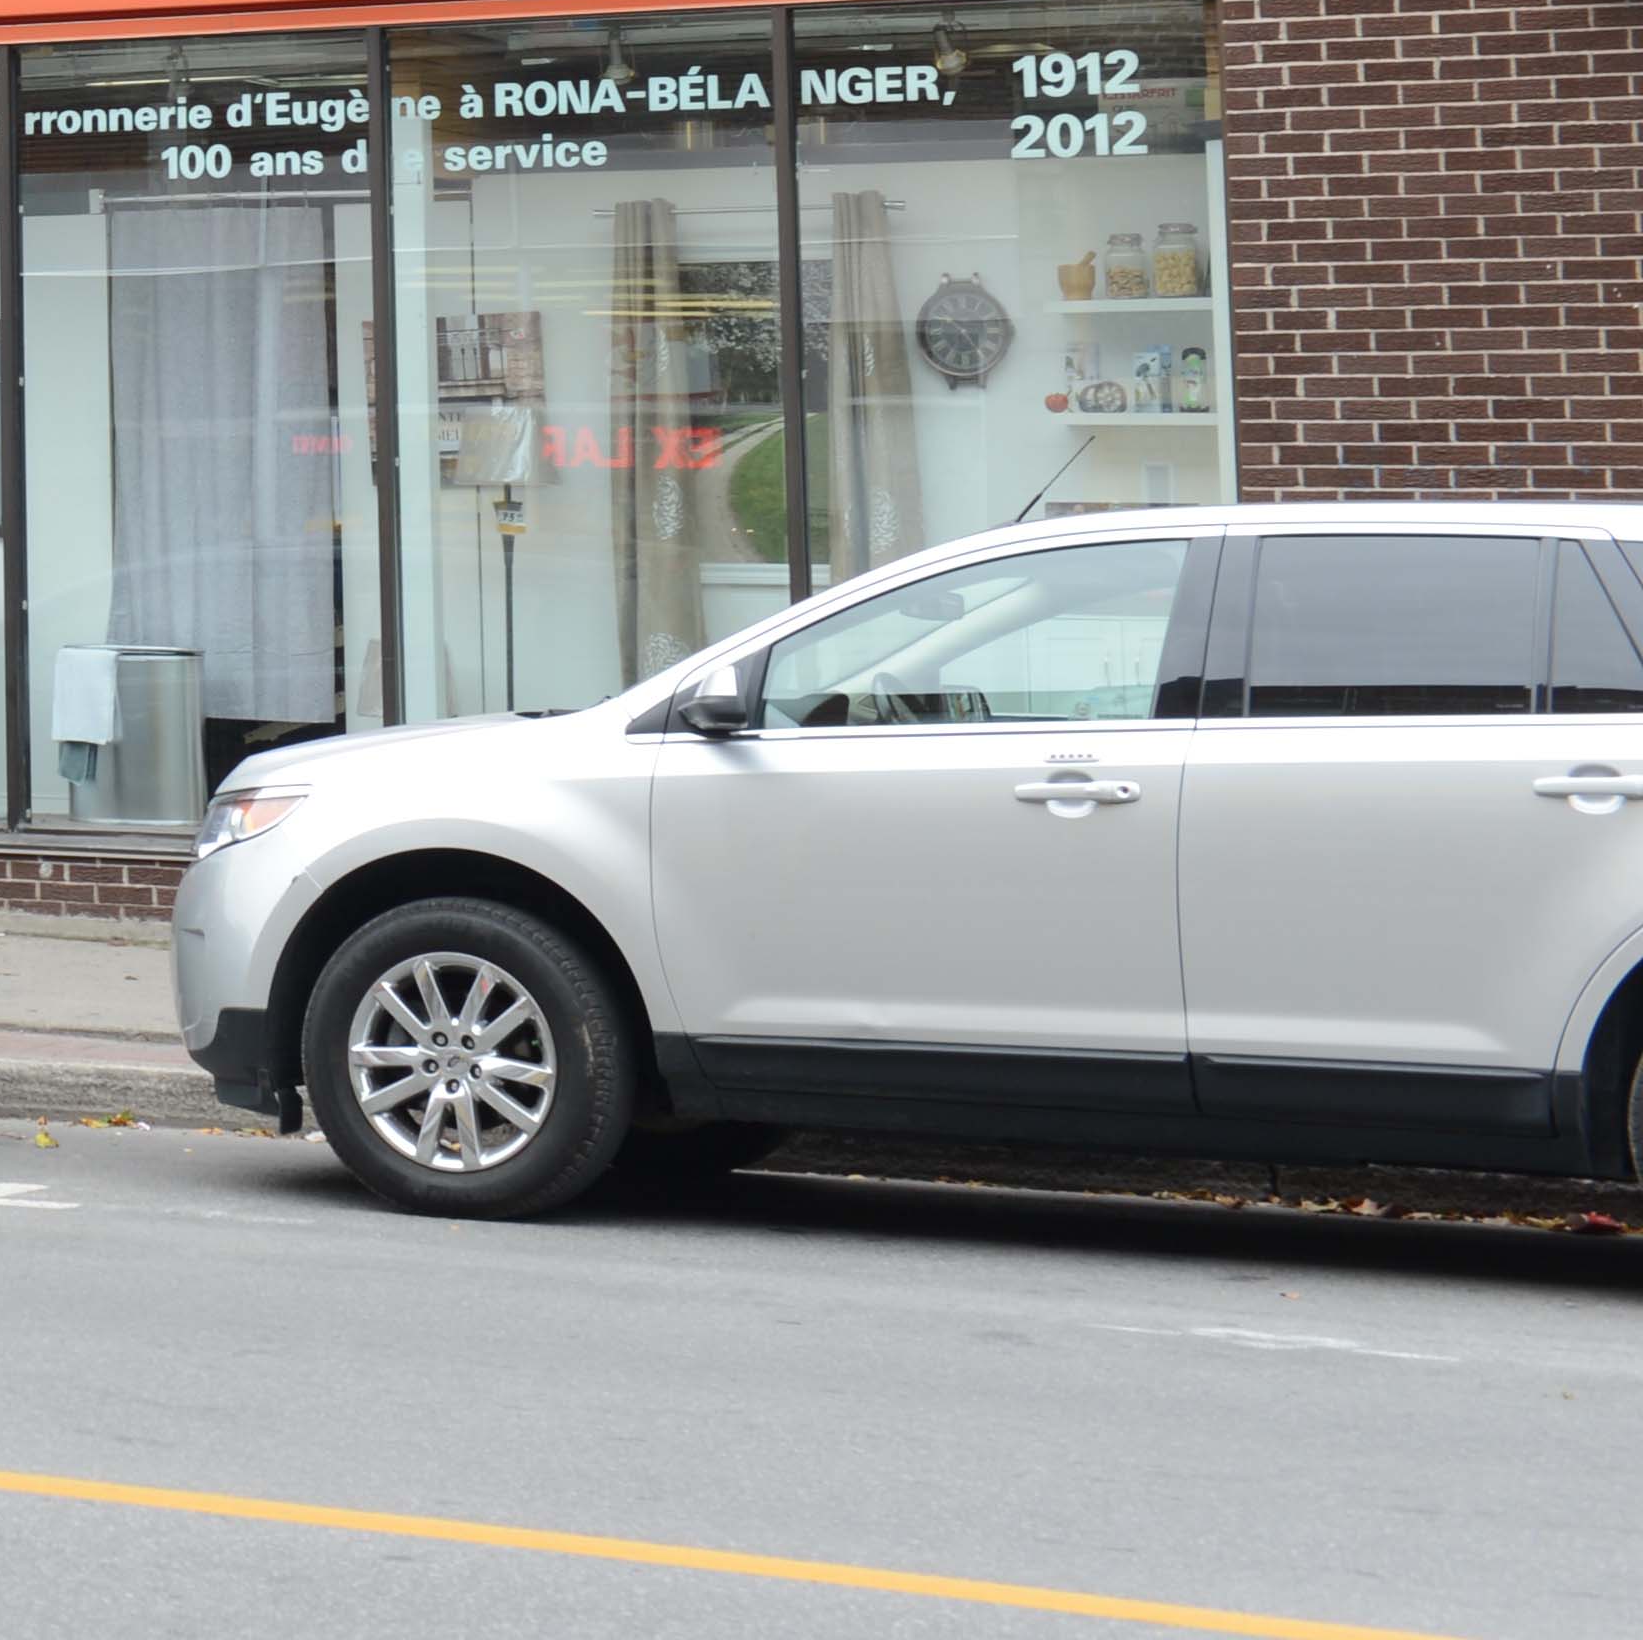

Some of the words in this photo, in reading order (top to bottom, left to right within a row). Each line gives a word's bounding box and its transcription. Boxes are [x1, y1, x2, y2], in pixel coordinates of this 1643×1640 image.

[1011, 48, 1140, 99] 1912
[226, 86, 442, 140] d'Eugène
[459, 83, 484, 120] à
[1010, 112, 1148, 160] 2012
[161, 142, 232, 182] 100
[250, 148, 324, 178] ans
[341, 138, 425, 175] de
[443, 133, 608, 174] service
